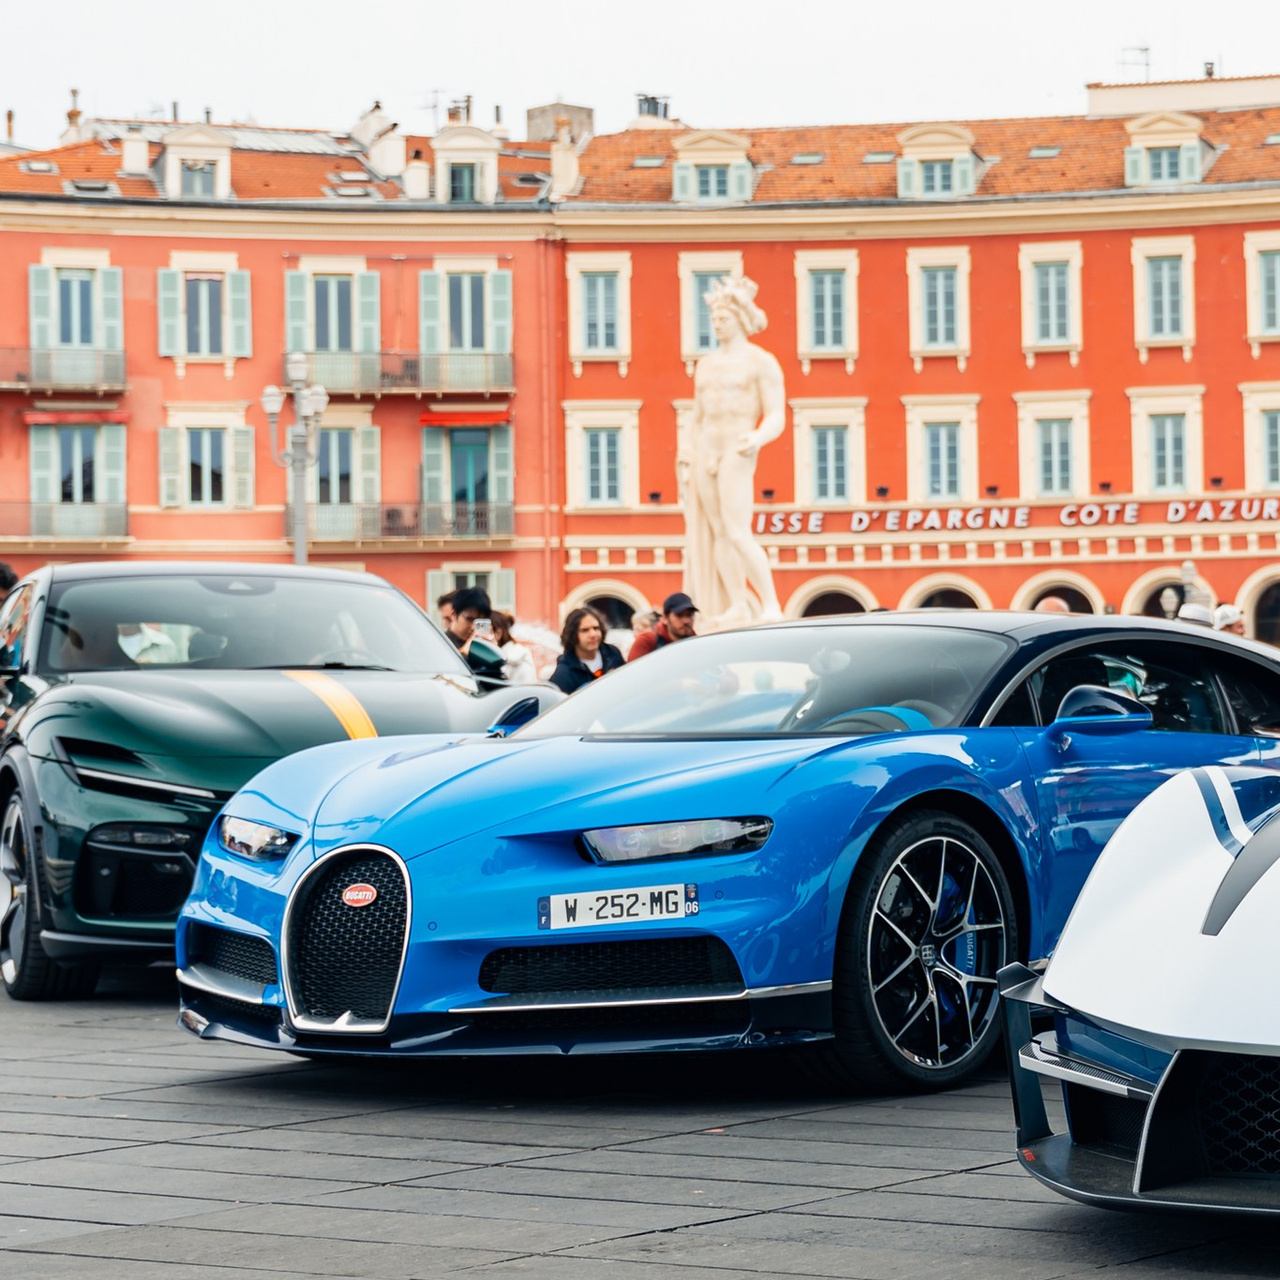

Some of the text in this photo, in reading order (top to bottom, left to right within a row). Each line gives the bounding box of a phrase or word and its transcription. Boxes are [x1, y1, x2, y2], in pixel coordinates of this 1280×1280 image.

[756, 498, 1280, 534] ISSE D'EPARGNE COTE D'AZUR
[685, 901, 699, 915] 06
[966, 932, 974, 968] BUGATTI
